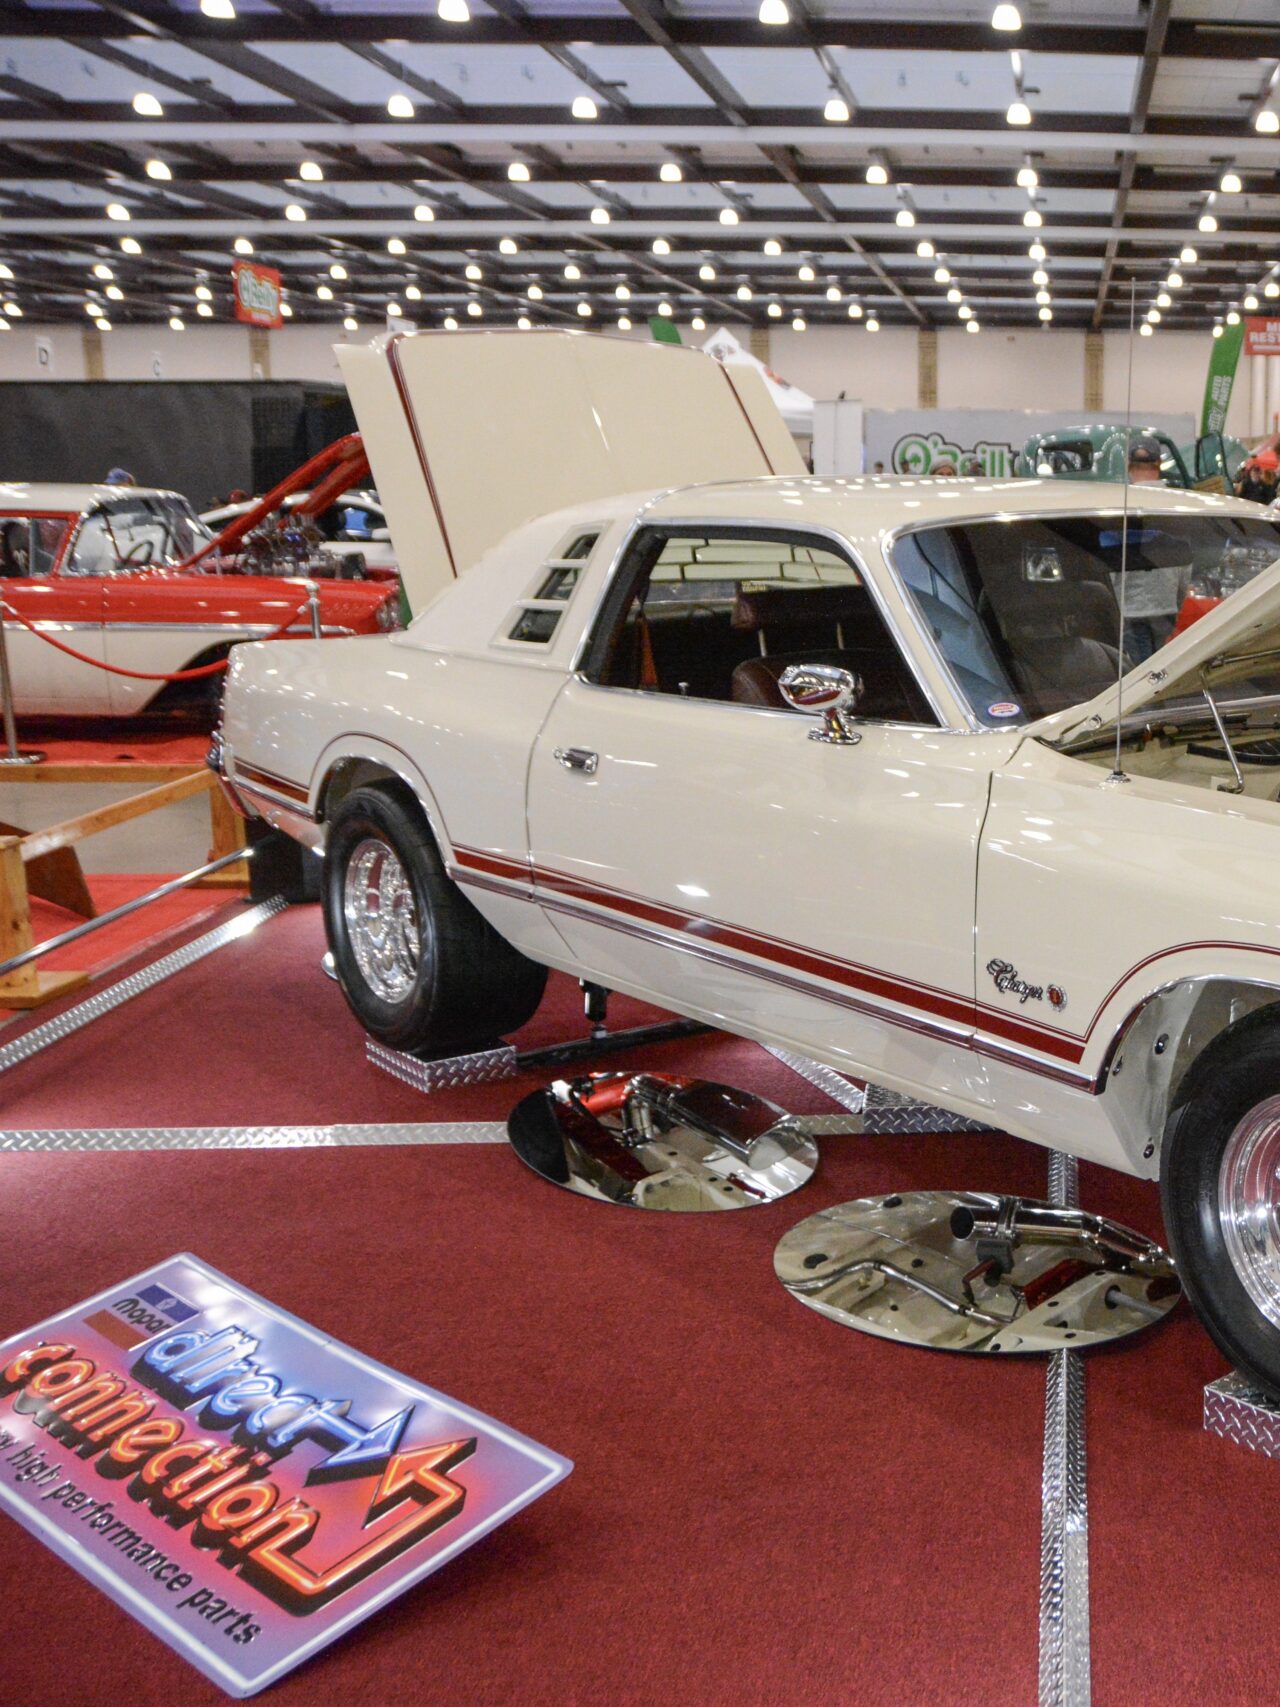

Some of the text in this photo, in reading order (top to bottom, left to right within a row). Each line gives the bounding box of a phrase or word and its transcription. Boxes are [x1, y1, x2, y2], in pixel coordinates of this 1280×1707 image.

[38, 346, 49, 366] D
[3, 1342, 321, 1552] connection
[146, 1325, 340, 1448] direct
[5, 1441, 263, 1646] high performance parts
